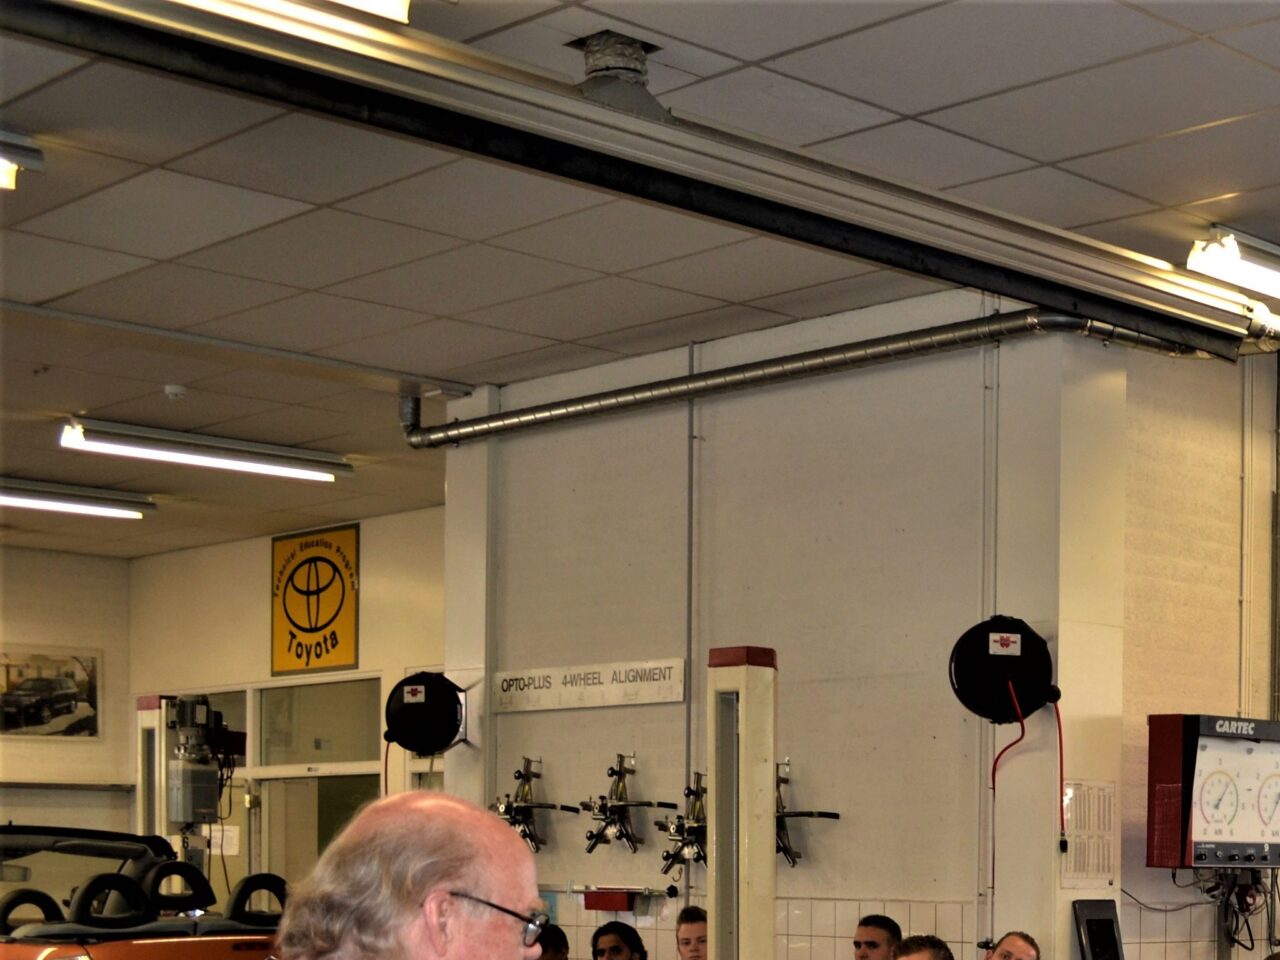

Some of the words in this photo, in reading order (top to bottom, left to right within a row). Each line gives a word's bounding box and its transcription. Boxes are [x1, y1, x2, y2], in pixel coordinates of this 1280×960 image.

[299, 538, 333, 551] Education
[287, 630, 339, 667] Toyota
[501, 675, 552, 693] OPTO-PLUS
[561, 672, 604, 688] 4-WHEEL
[611, 666, 674, 684] ALIGNMENT
[1215, 719, 1256, 735] CARTEC
